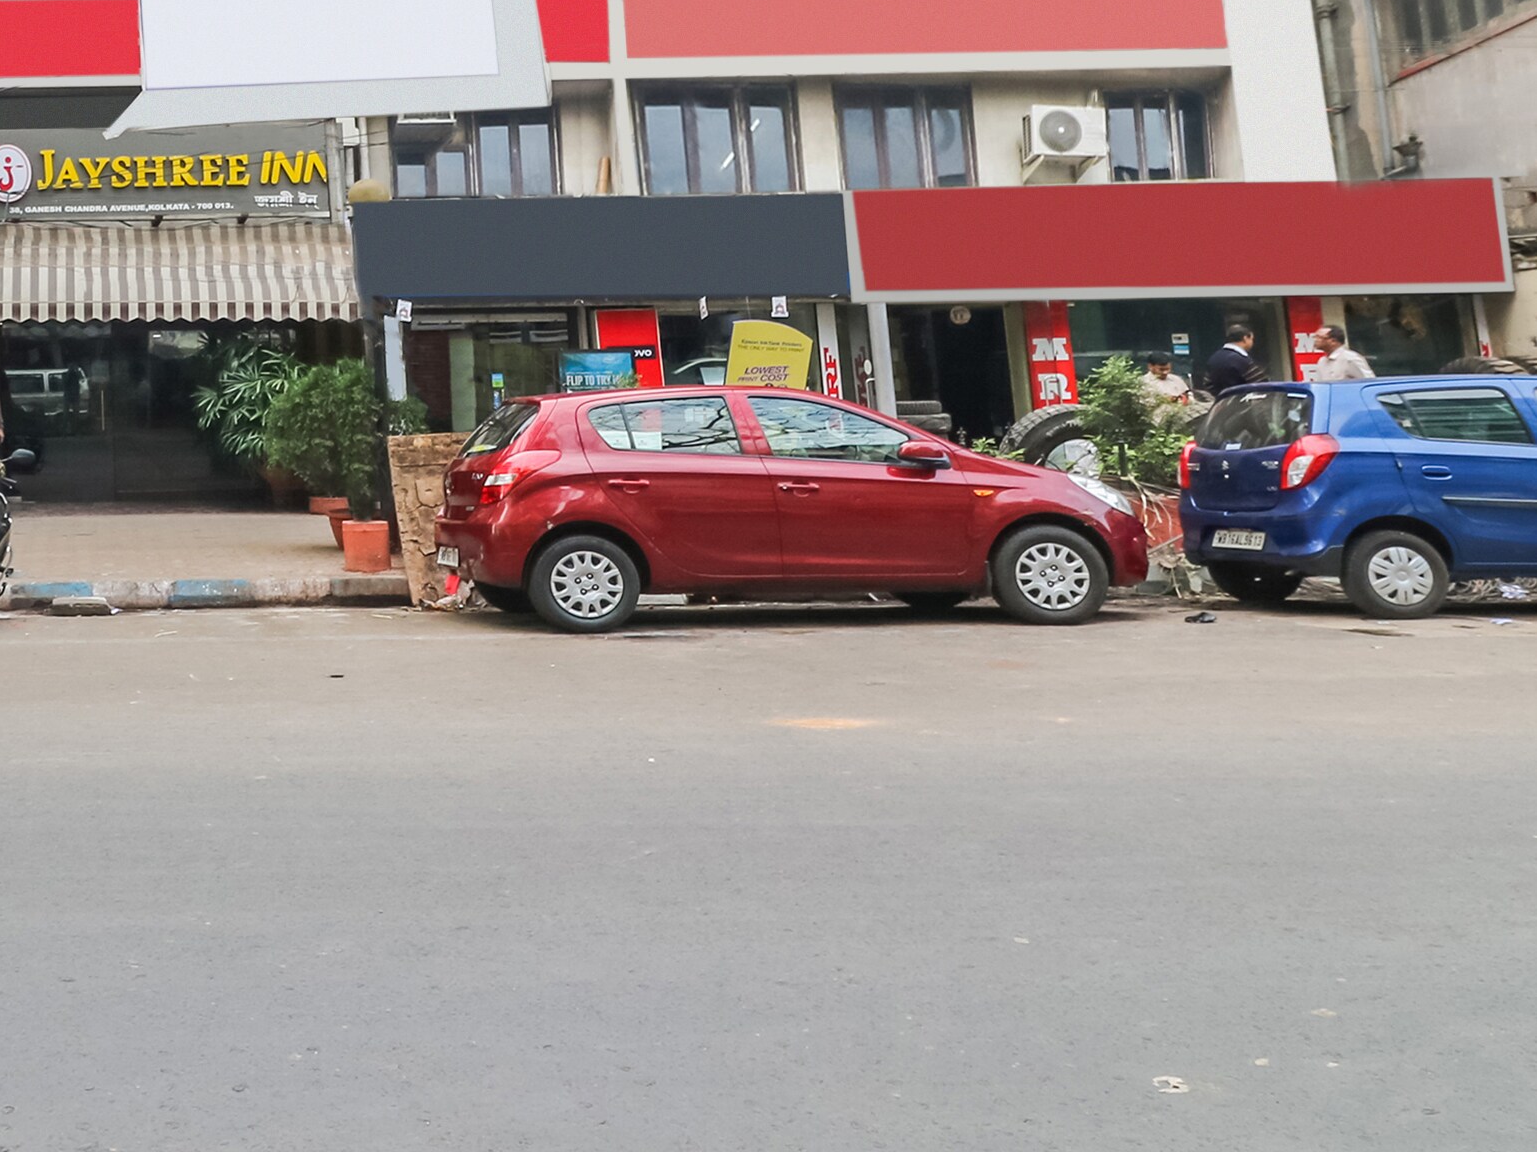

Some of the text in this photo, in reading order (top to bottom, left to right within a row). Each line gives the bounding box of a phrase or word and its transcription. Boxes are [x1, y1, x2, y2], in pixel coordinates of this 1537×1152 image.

[37, 149, 328, 191] JAYSHREE INN
[25, 205, 62, 214] GANESH
[64, 204, 108, 213] CHANDRA
[197, 202, 213, 210] 700
[744, 365, 789, 375] LOWEST
[566, 374, 583, 386] FLIP
[584, 374, 595, 386] TO
[596, 374, 611, 386] TRY
[760, 373, 789, 382] COST
